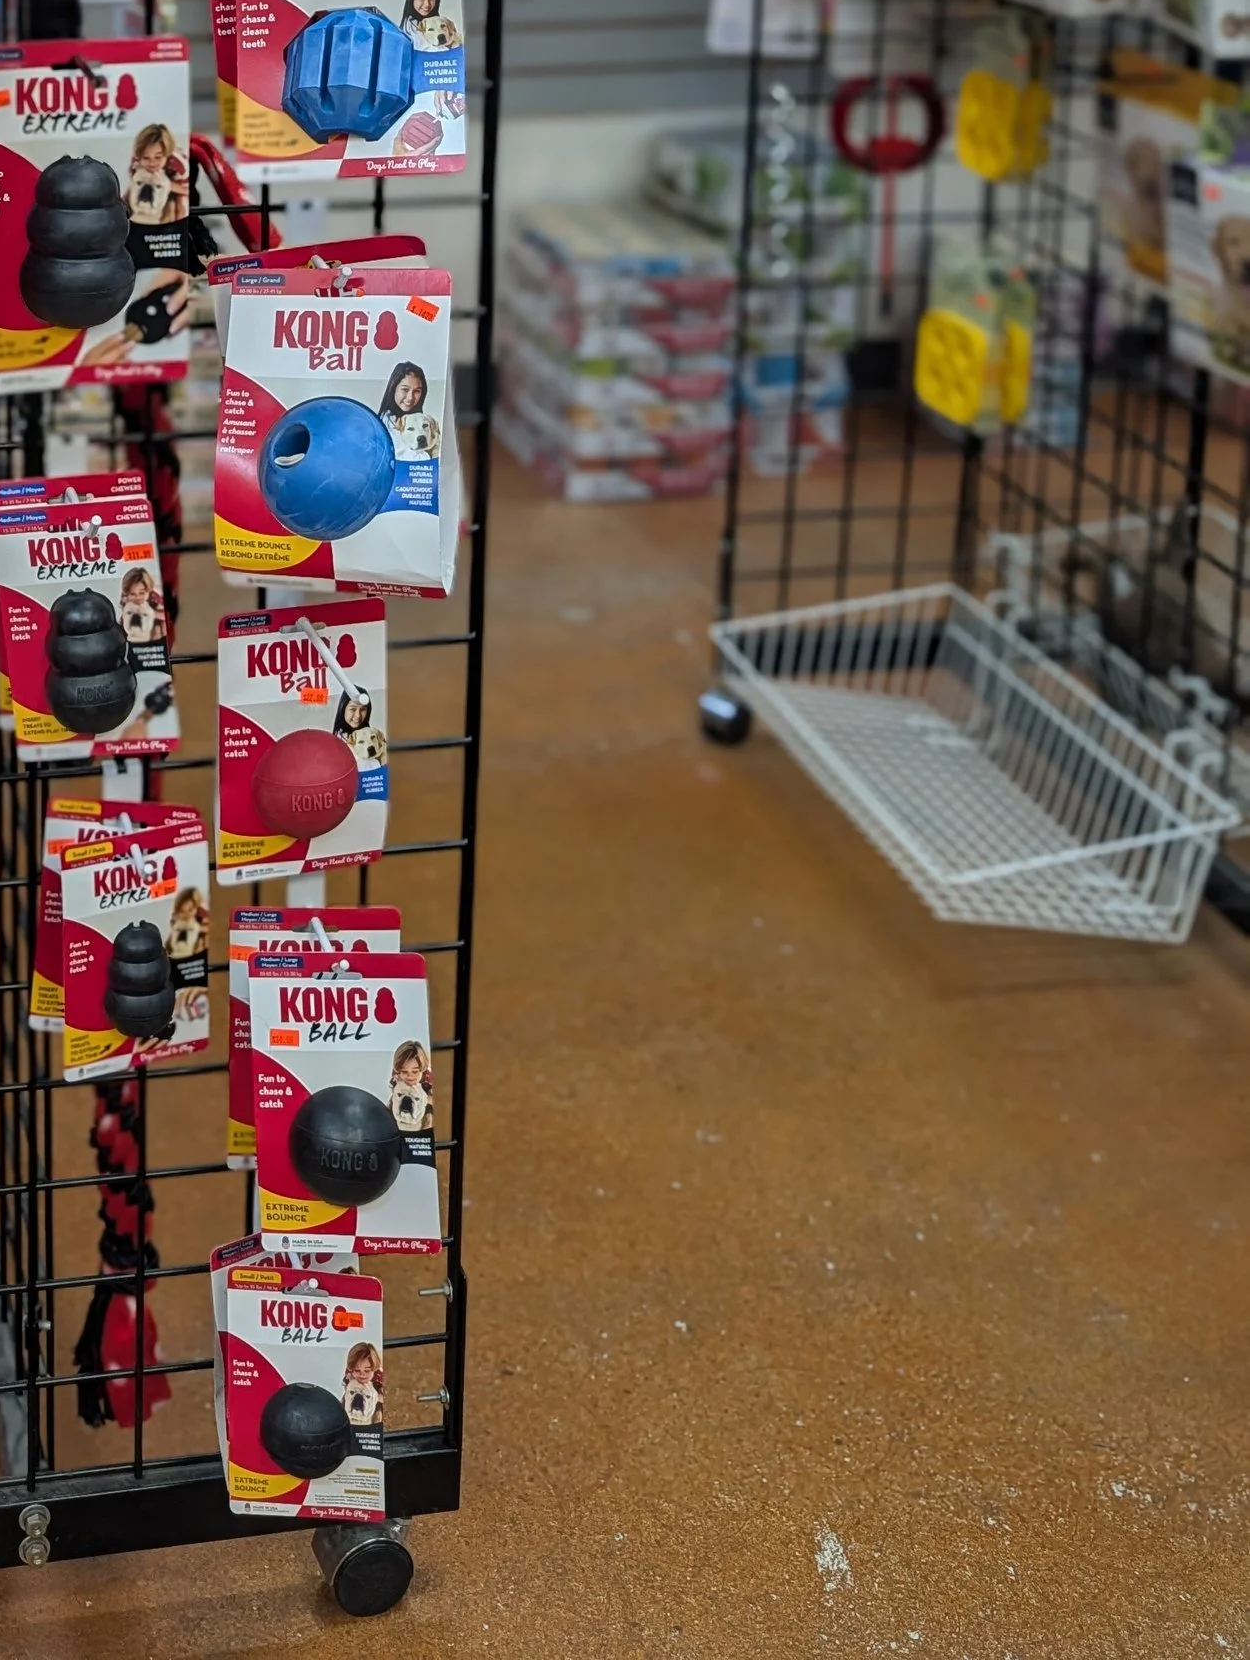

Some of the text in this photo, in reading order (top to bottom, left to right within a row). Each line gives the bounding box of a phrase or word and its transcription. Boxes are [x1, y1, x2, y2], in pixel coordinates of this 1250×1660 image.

[241, 2, 269, 12] Fun to
[242, 14, 275, 24] chase &
[242, 27, 269, 36] cleans
[242, 39, 266, 48] teeth
[424, 68, 457, 76] NATURAL
[429, 76, 457, 84] RUBBER
[16, 78, 108, 116] KONG
[22, 111, 129, 135] EXTREME
[273, 310, 369, 349] KONG
[308, 345, 362, 371] Ball
[123, 504, 148, 513] POWER
[116, 512, 148, 521] CHEWERS
[220, 538, 292, 551] EXTREME BOUNCE
[28, 535, 100, 568] KONG
[221, 550, 290, 561] REBOND EXTRÊME
[36, 560, 118, 580] EXTREME
[280, 666, 327, 693] Ball
[224, 727, 251, 736] Fun to
[224, 738, 249, 747] chase
[224, 749, 248, 758] catch
[291, 791, 333, 813] KONG
[99, 886, 152, 910] EXTRE
[279, 986, 369, 1024] KONG
[308, 1022, 372, 1043] BALL
[320, 1148, 363, 1172] KONG
[266, 1203, 309, 1214] EXTREME
[266, 1213, 307, 1223] BOUNCE
[260, 1299, 328, 1328] KONG
[281, 1327, 330, 1343] BALL
[234, 1476, 269, 1486] EXTREME
[234, 1485, 267, 1493] BOUNCE
